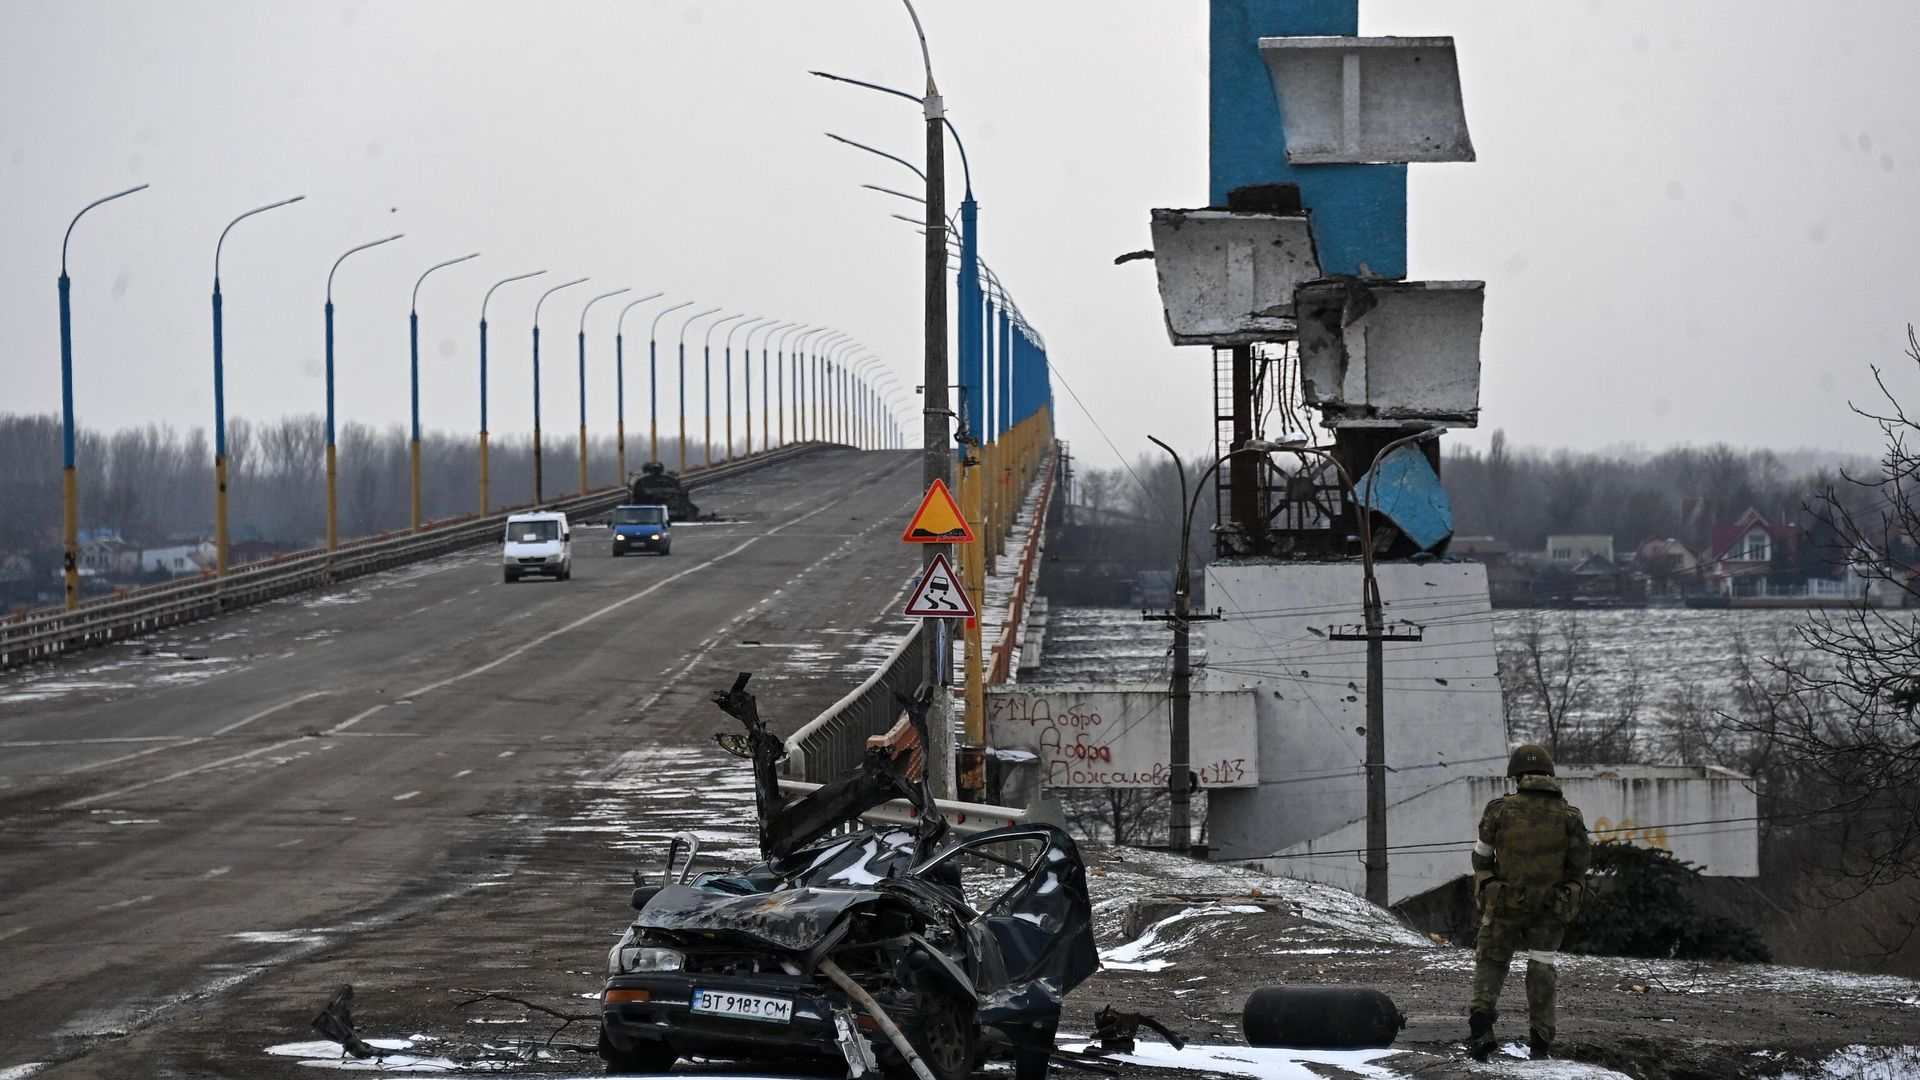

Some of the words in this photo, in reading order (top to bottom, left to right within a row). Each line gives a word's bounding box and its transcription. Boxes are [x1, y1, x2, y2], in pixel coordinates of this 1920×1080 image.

[702, 994, 723, 1010] BT
[726, 997, 760, 1014] 9183
[764, 1001, 787, 1018] CM
